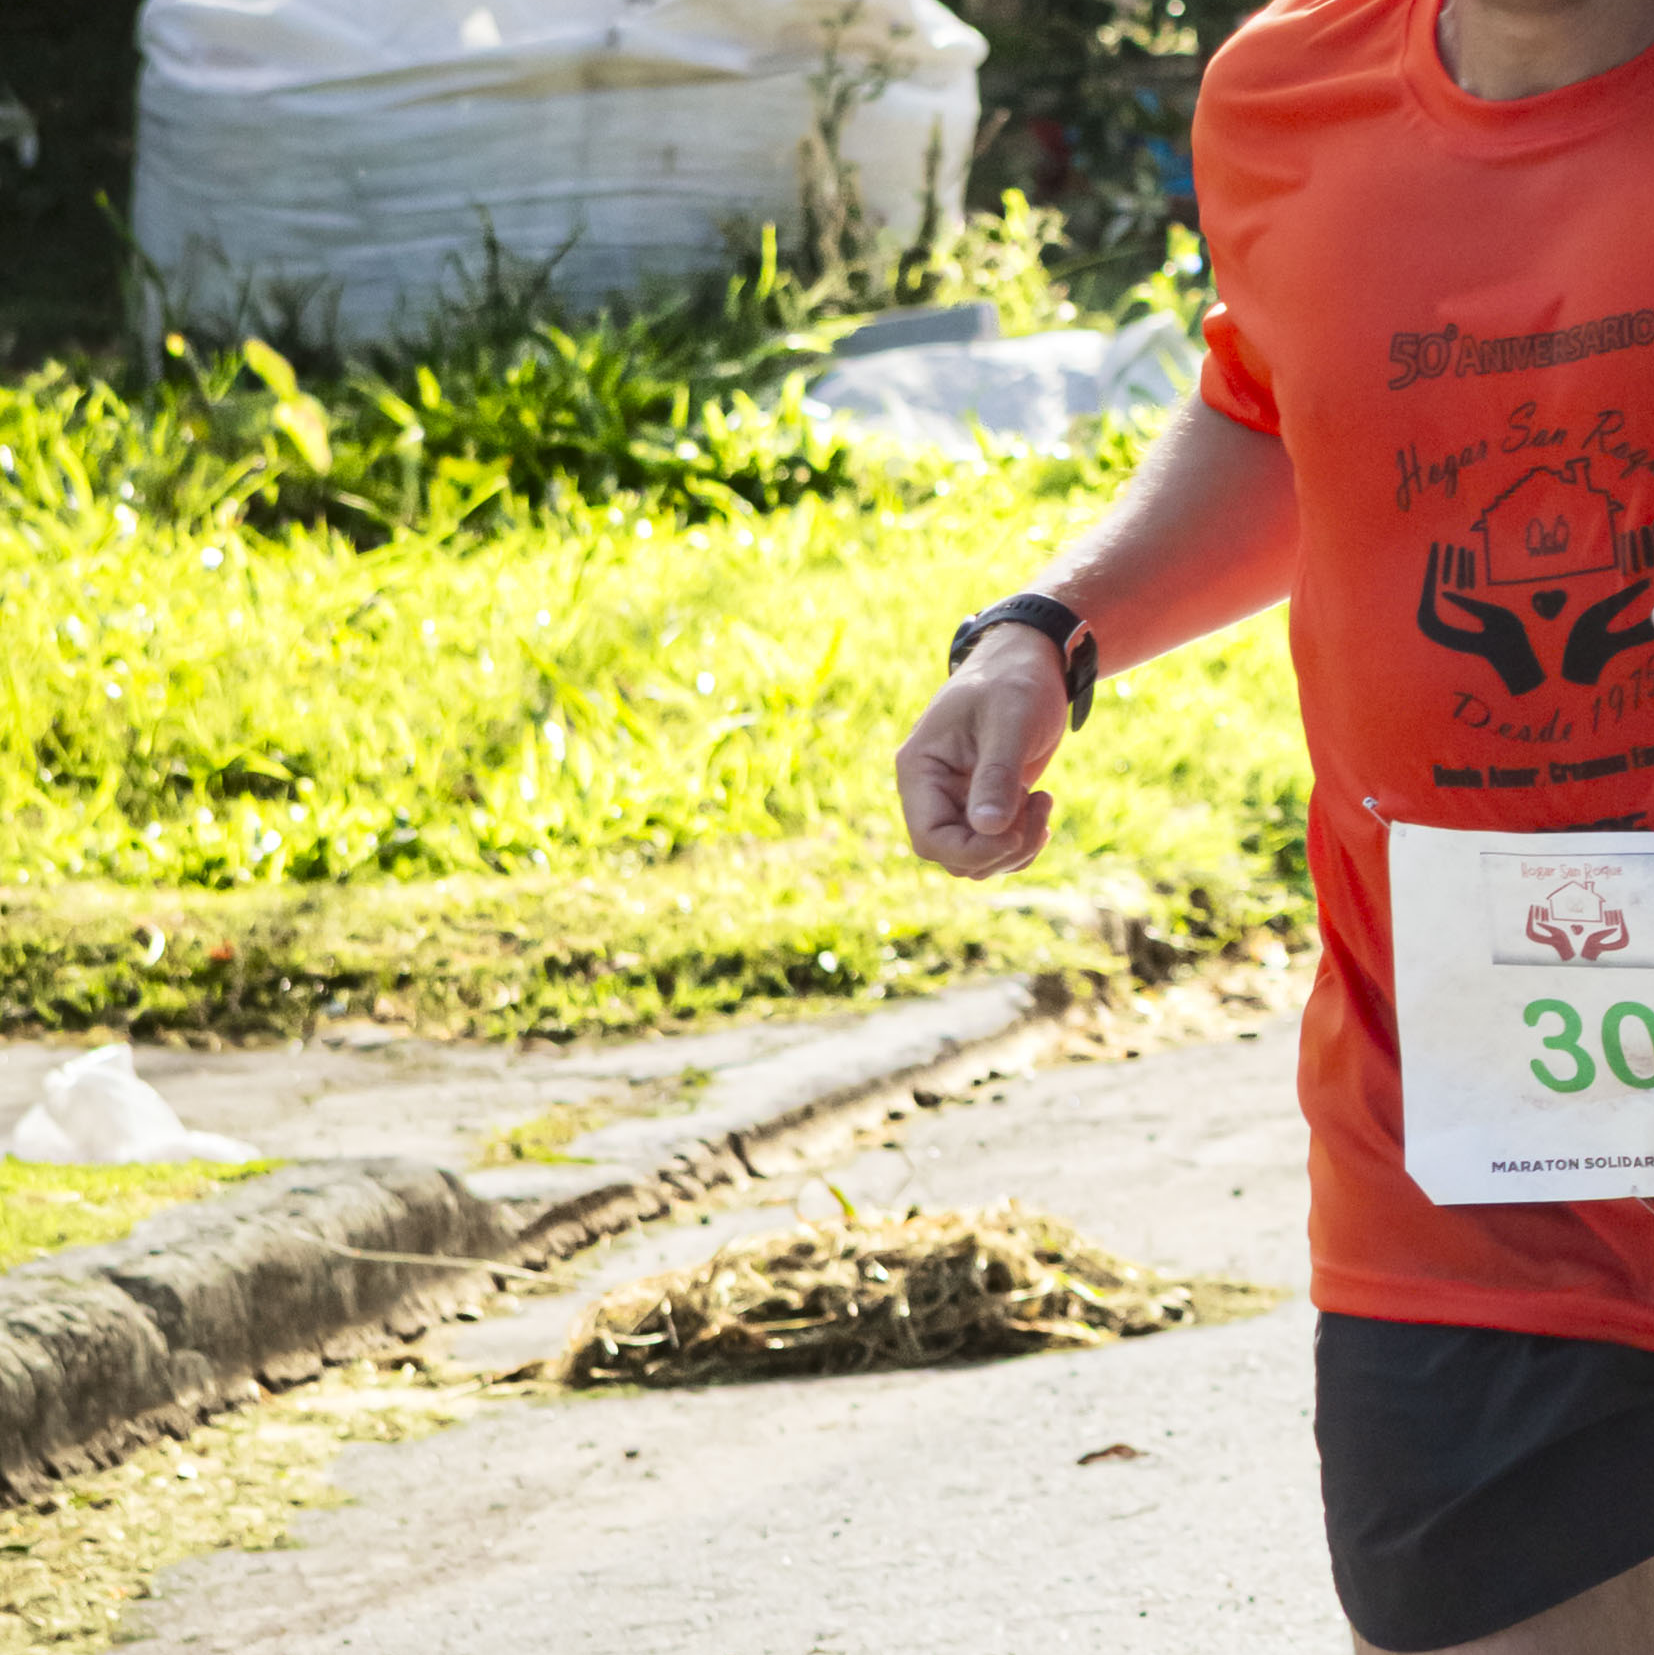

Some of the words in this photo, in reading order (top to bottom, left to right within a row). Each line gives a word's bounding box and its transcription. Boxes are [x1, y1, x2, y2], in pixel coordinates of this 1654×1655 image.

[1501, 400, 1568, 454] San
[1453, 691, 1573, 743] Desde
[1559, 863, 1581, 879] San
[1491, 1157, 1580, 1174] MARATON
